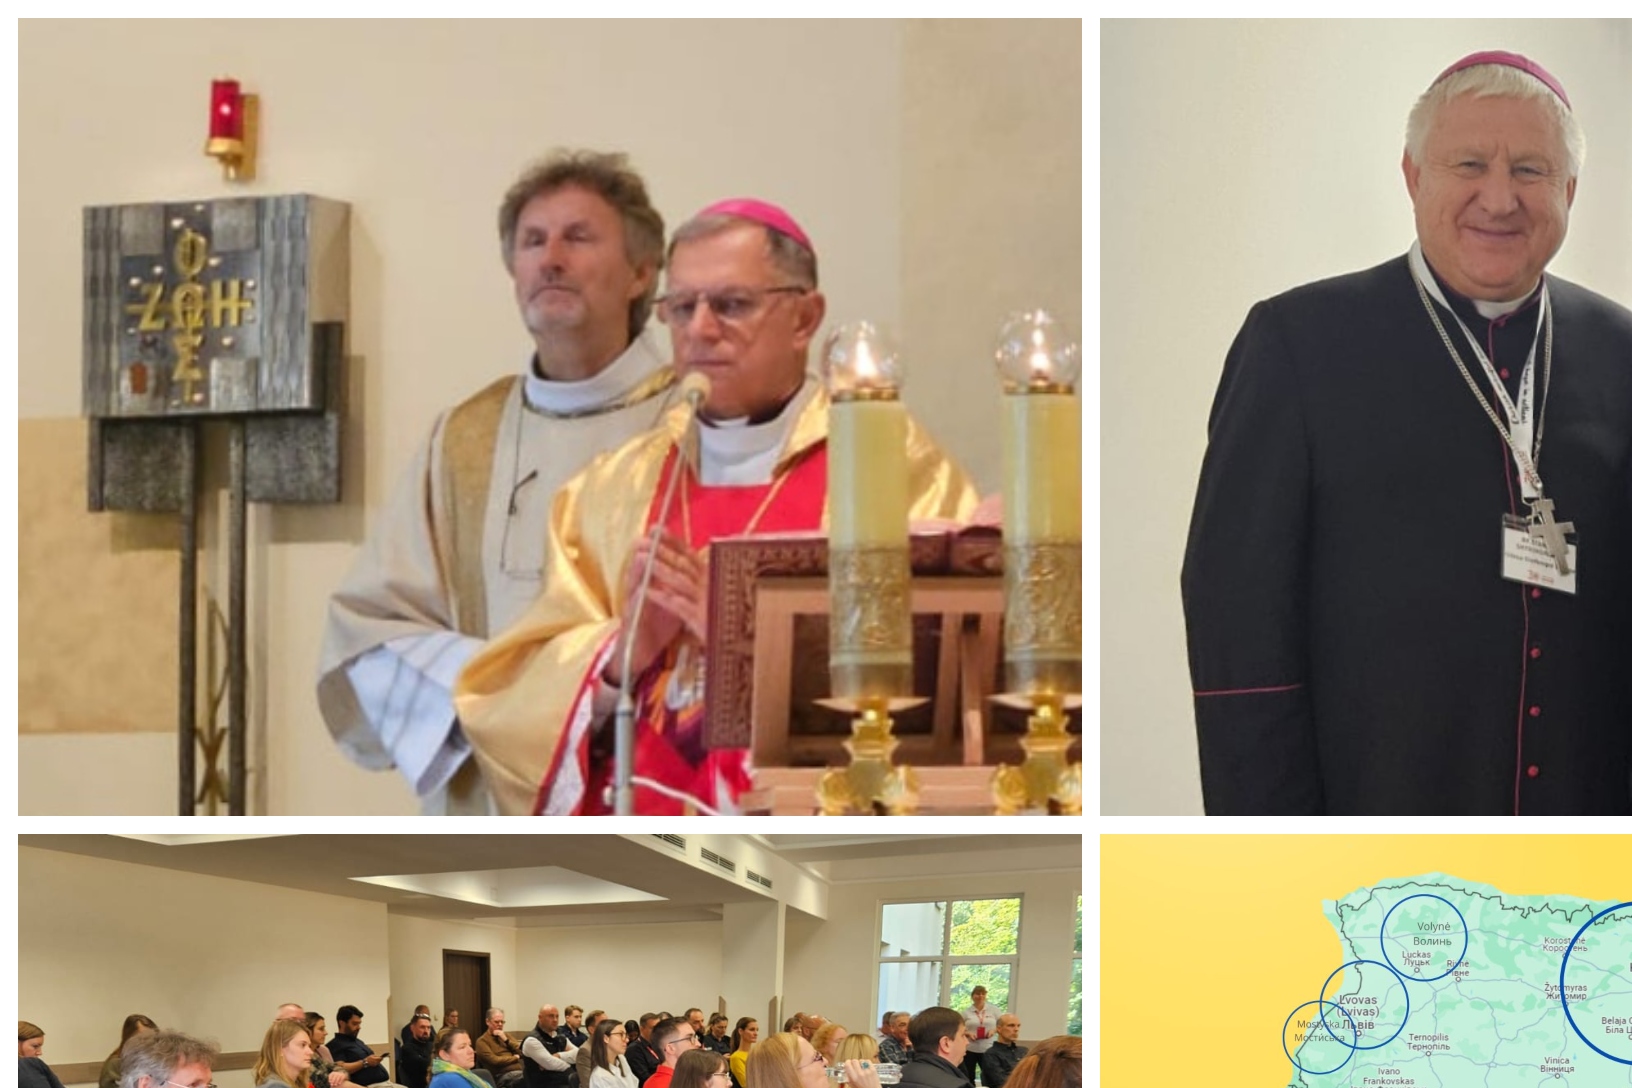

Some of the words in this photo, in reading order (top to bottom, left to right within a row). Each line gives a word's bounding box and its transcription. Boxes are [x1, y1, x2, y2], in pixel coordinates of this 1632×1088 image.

[1417, 922, 1450, 933] Volynė
[1414, 937, 1452, 945] Волинь
[1404, 959, 1430, 967] Луцьк
[1339, 995, 1377, 1005] Lvovas
[1342, 1020, 1374, 1029] Львів
[1602, 1017, 1626, 1025] Belaja
[1606, 1026, 1624, 1034] Біла
[1409, 1033, 1449, 1043] Ternopilis
[1407, 1043, 1450, 1051] Тернопіль
[1540, 1065, 1574, 1074] Вінниця
[1363, 1077, 1414, 1085] Frankovskas
